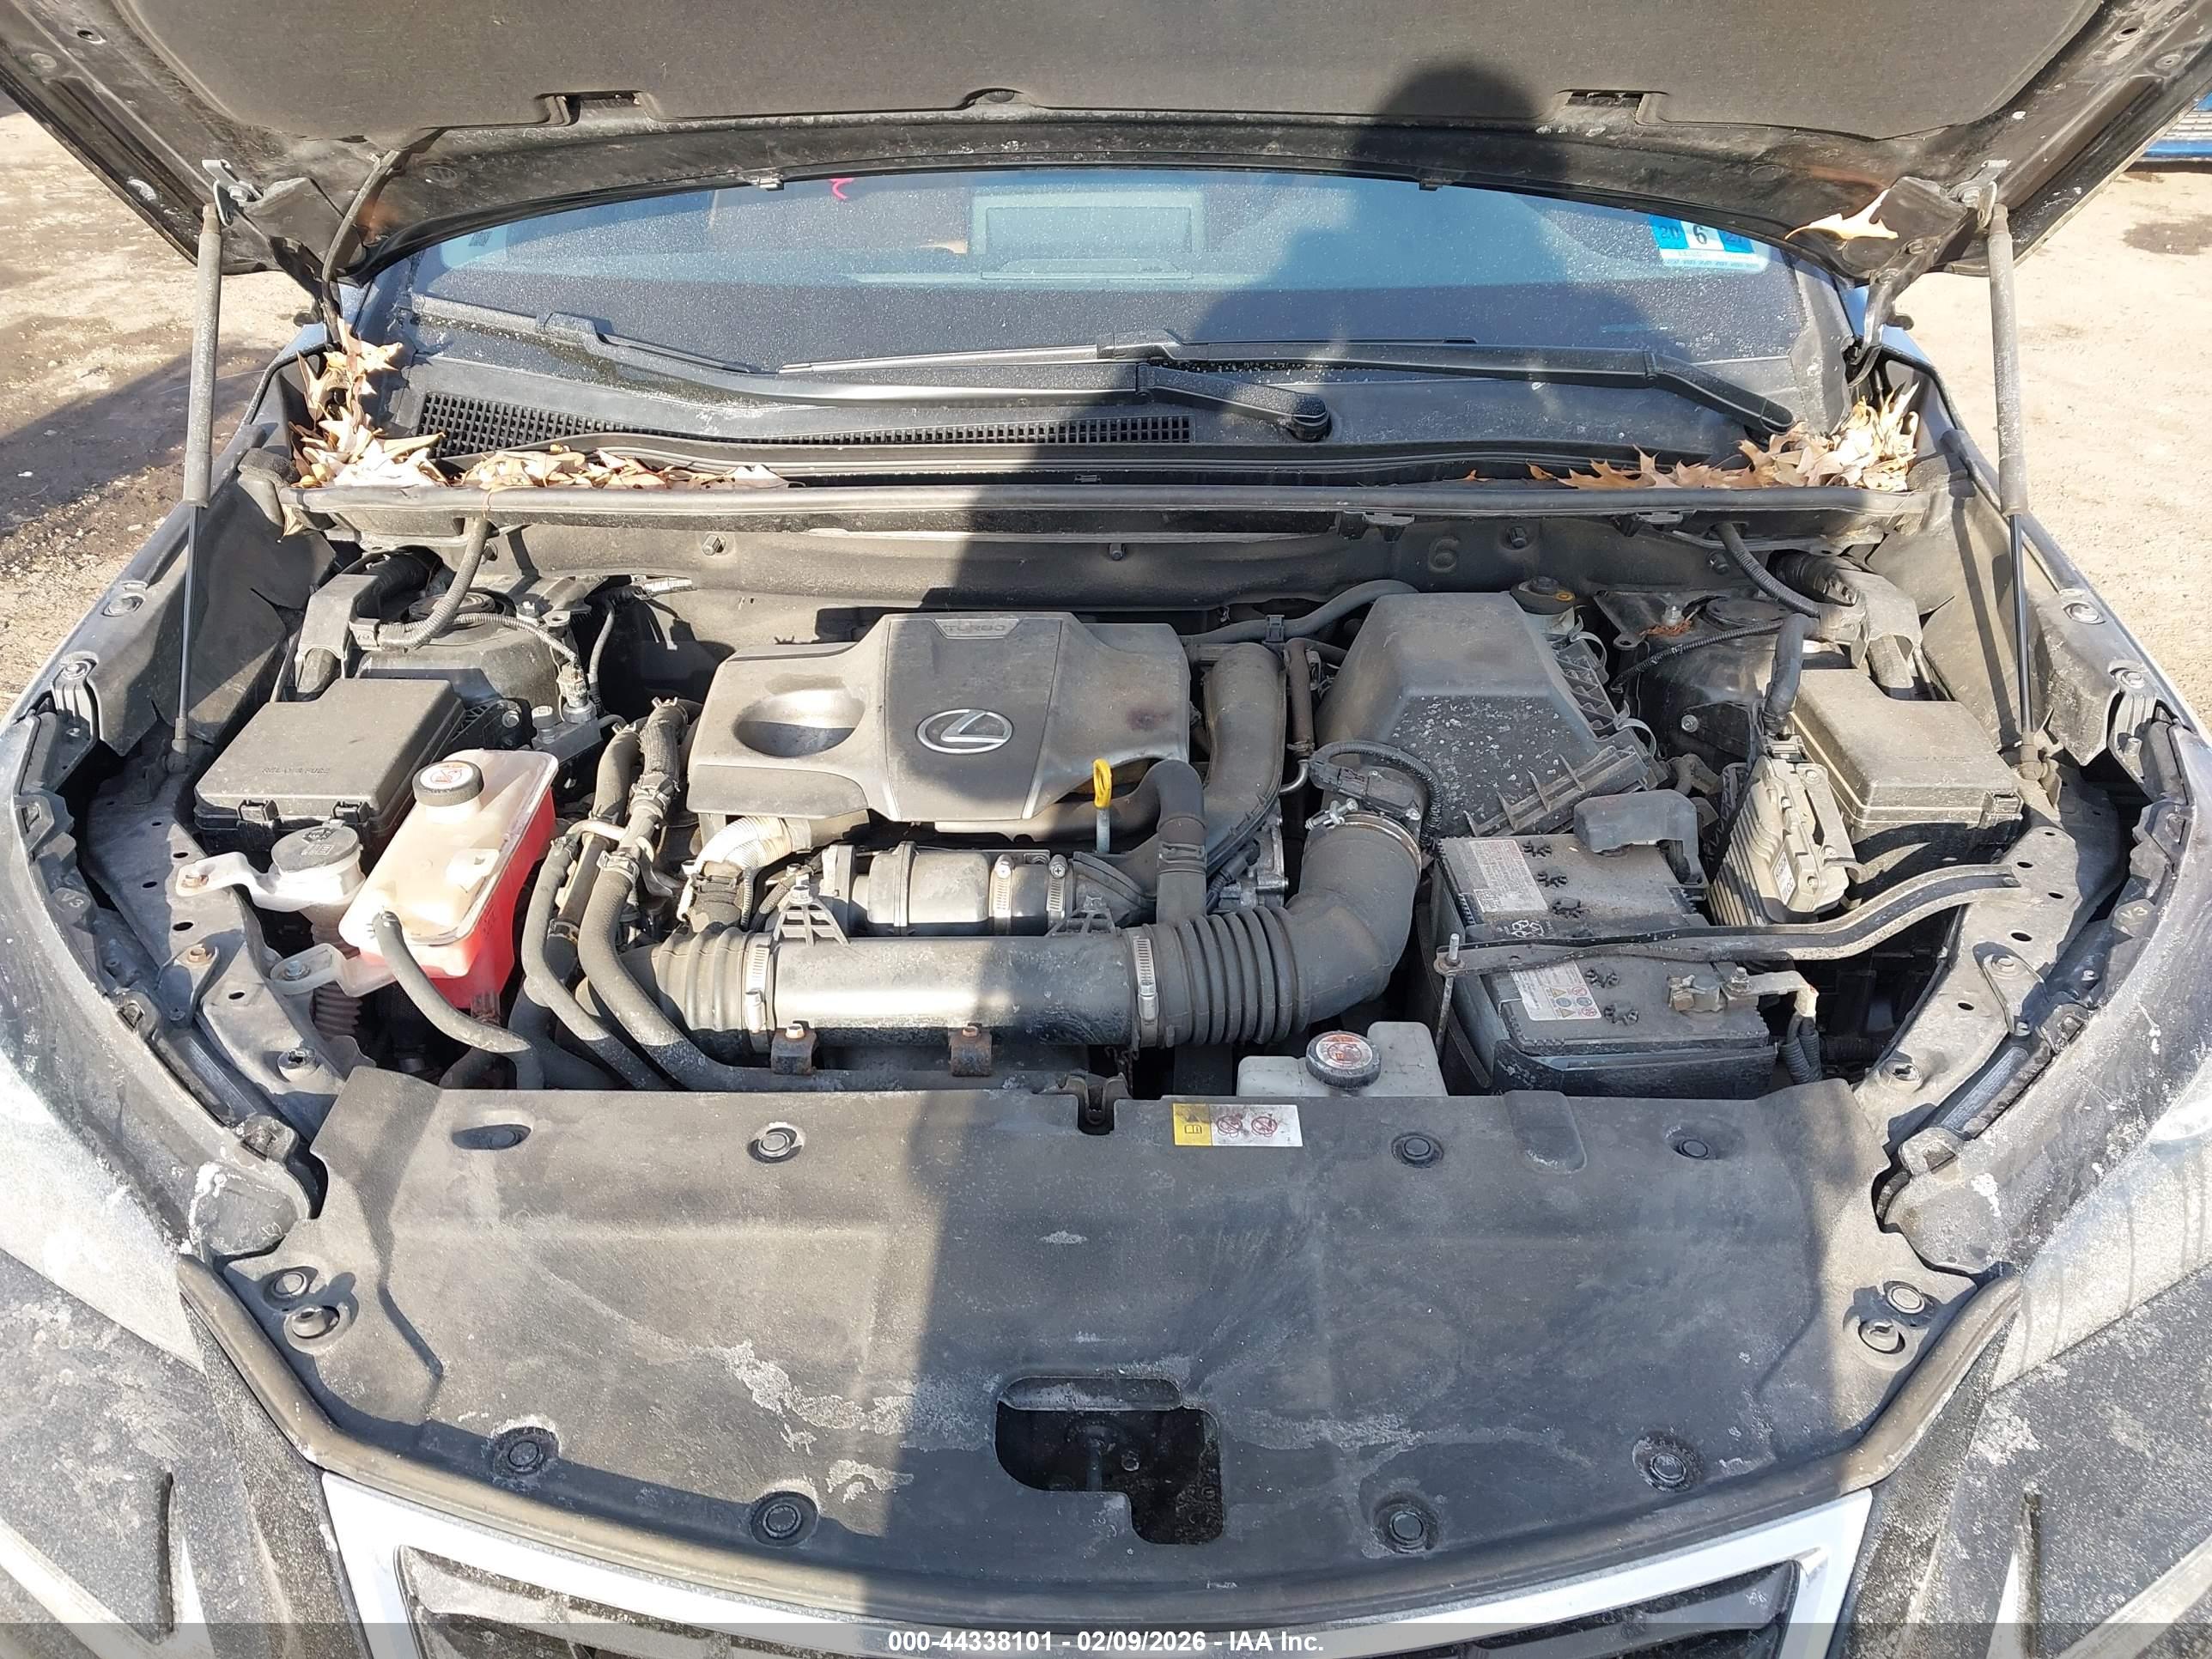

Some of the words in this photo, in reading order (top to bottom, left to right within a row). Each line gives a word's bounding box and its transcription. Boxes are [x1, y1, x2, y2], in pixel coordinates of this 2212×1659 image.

[1693, 225, 1707, 245] 6
[60, 892, 84, 908] V3
[2120, 906, 2148, 920] V3
